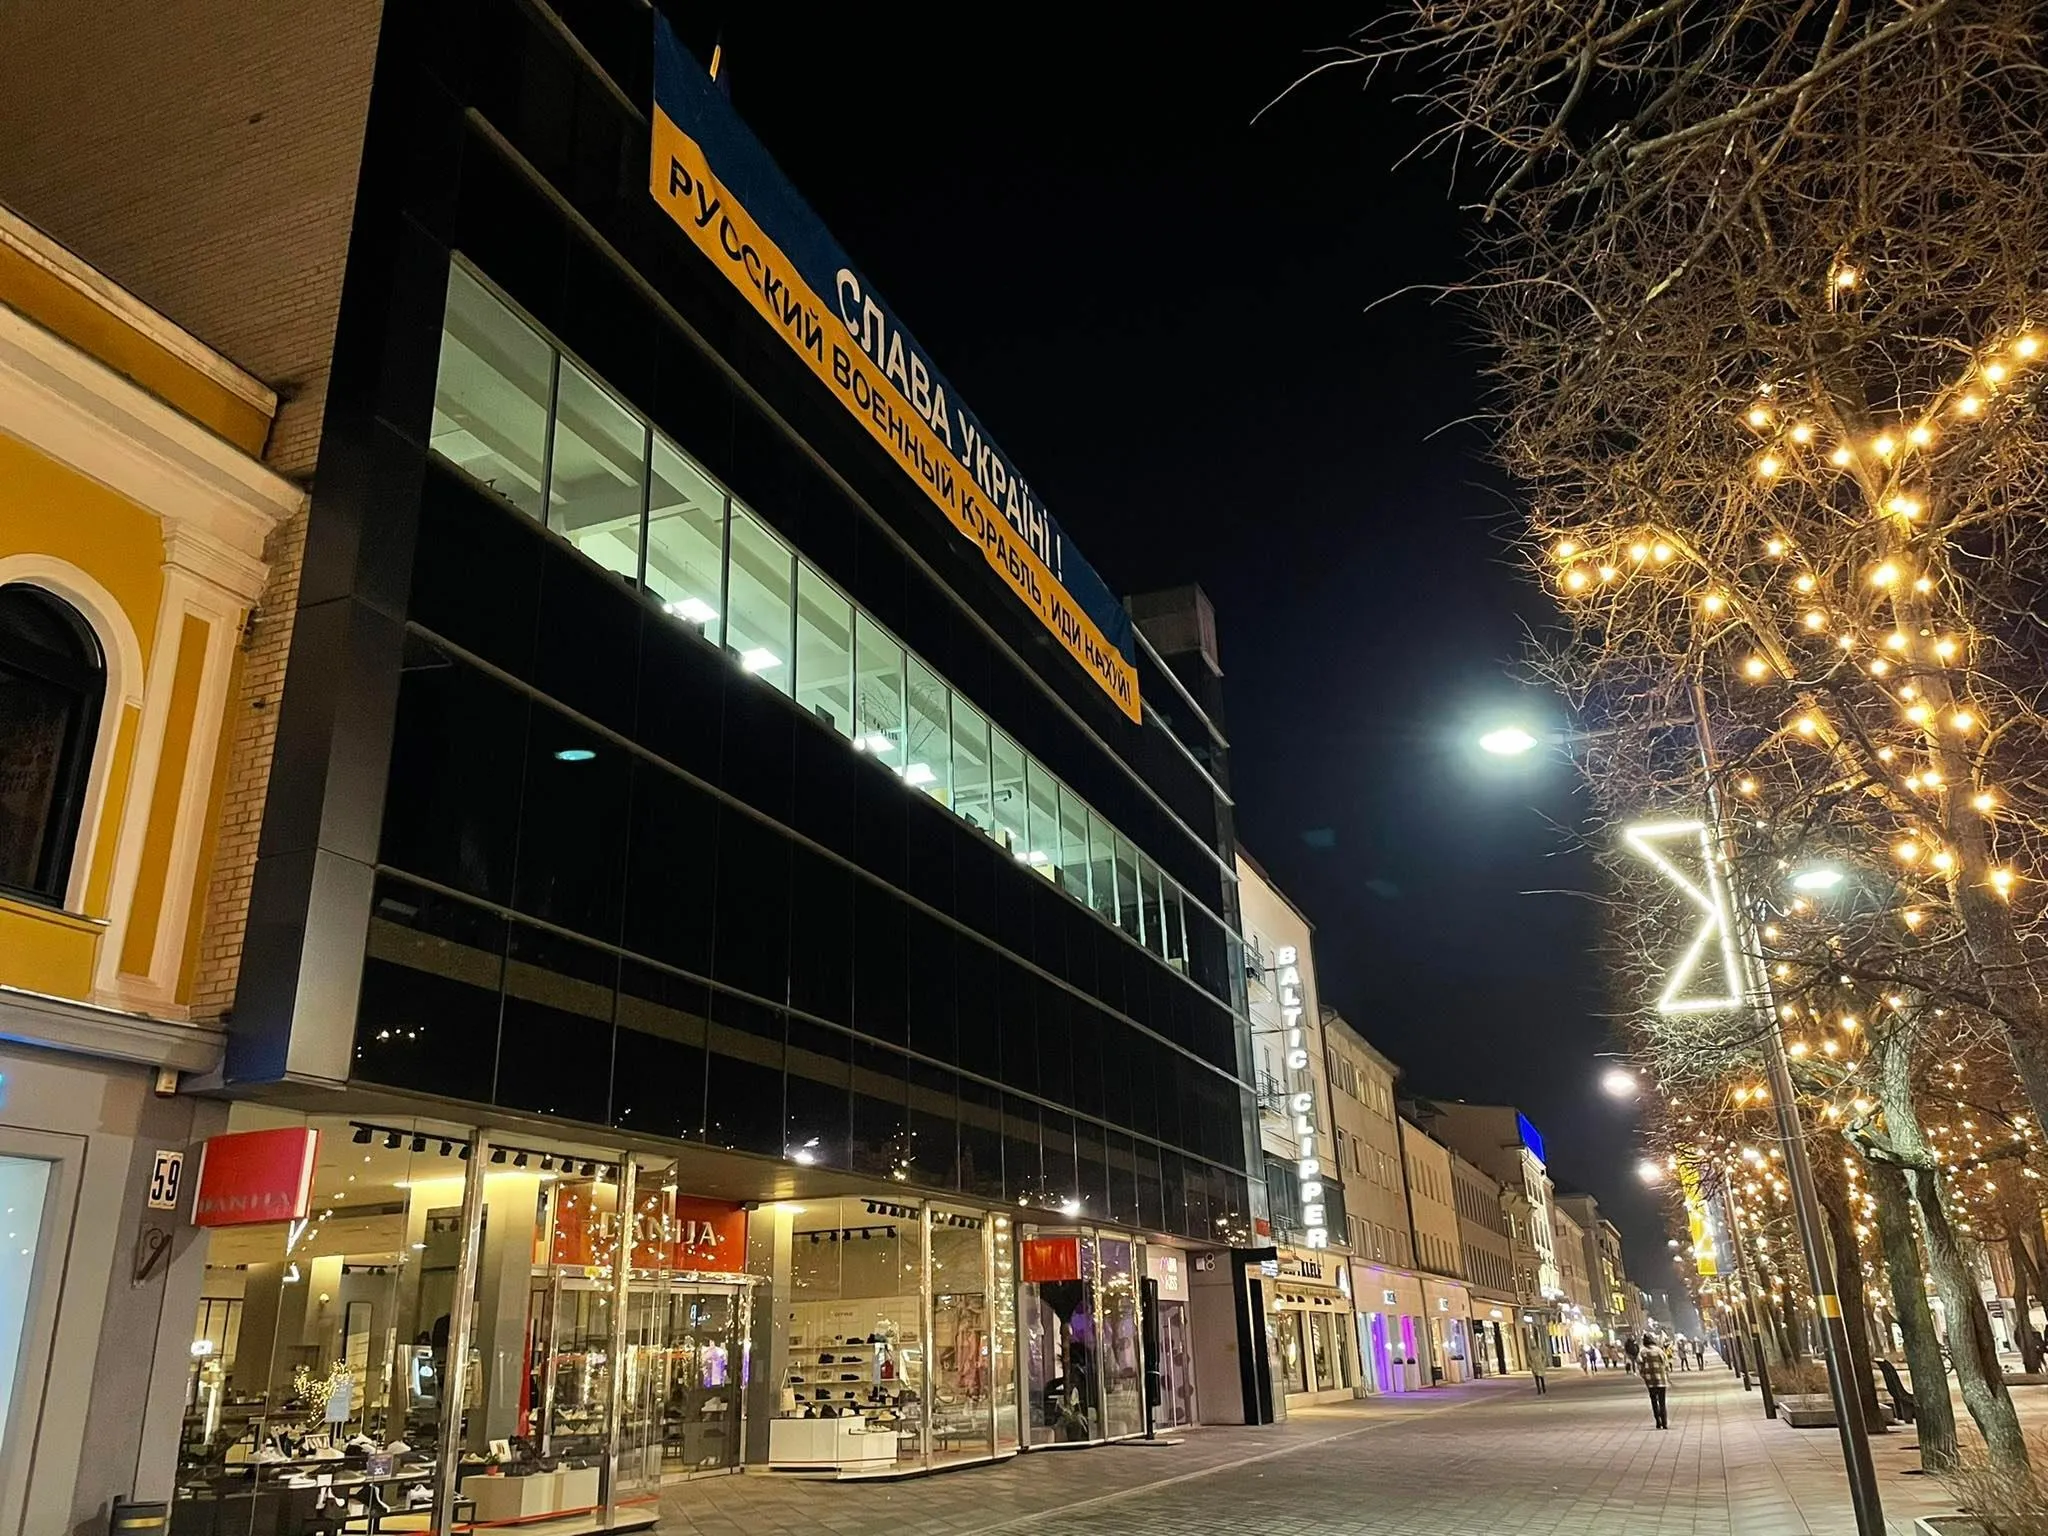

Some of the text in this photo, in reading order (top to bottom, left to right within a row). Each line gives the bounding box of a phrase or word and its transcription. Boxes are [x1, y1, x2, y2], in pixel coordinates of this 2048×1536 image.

[669, 153, 824, 363] РУССКИЙ
[832, 343, 956, 508] ВОЕННЫЙ
[1050, 594, 1082, 651] ИДИ
[1084, 633, 1132, 706] НАХУЙ!
[836, 268, 953, 450] СЛАВА
[1279, 945, 1308, 1070] BALTIC
[150, 1158, 181, 1202] 59
[1293, 1092, 1329, 1249] CLIPPER
